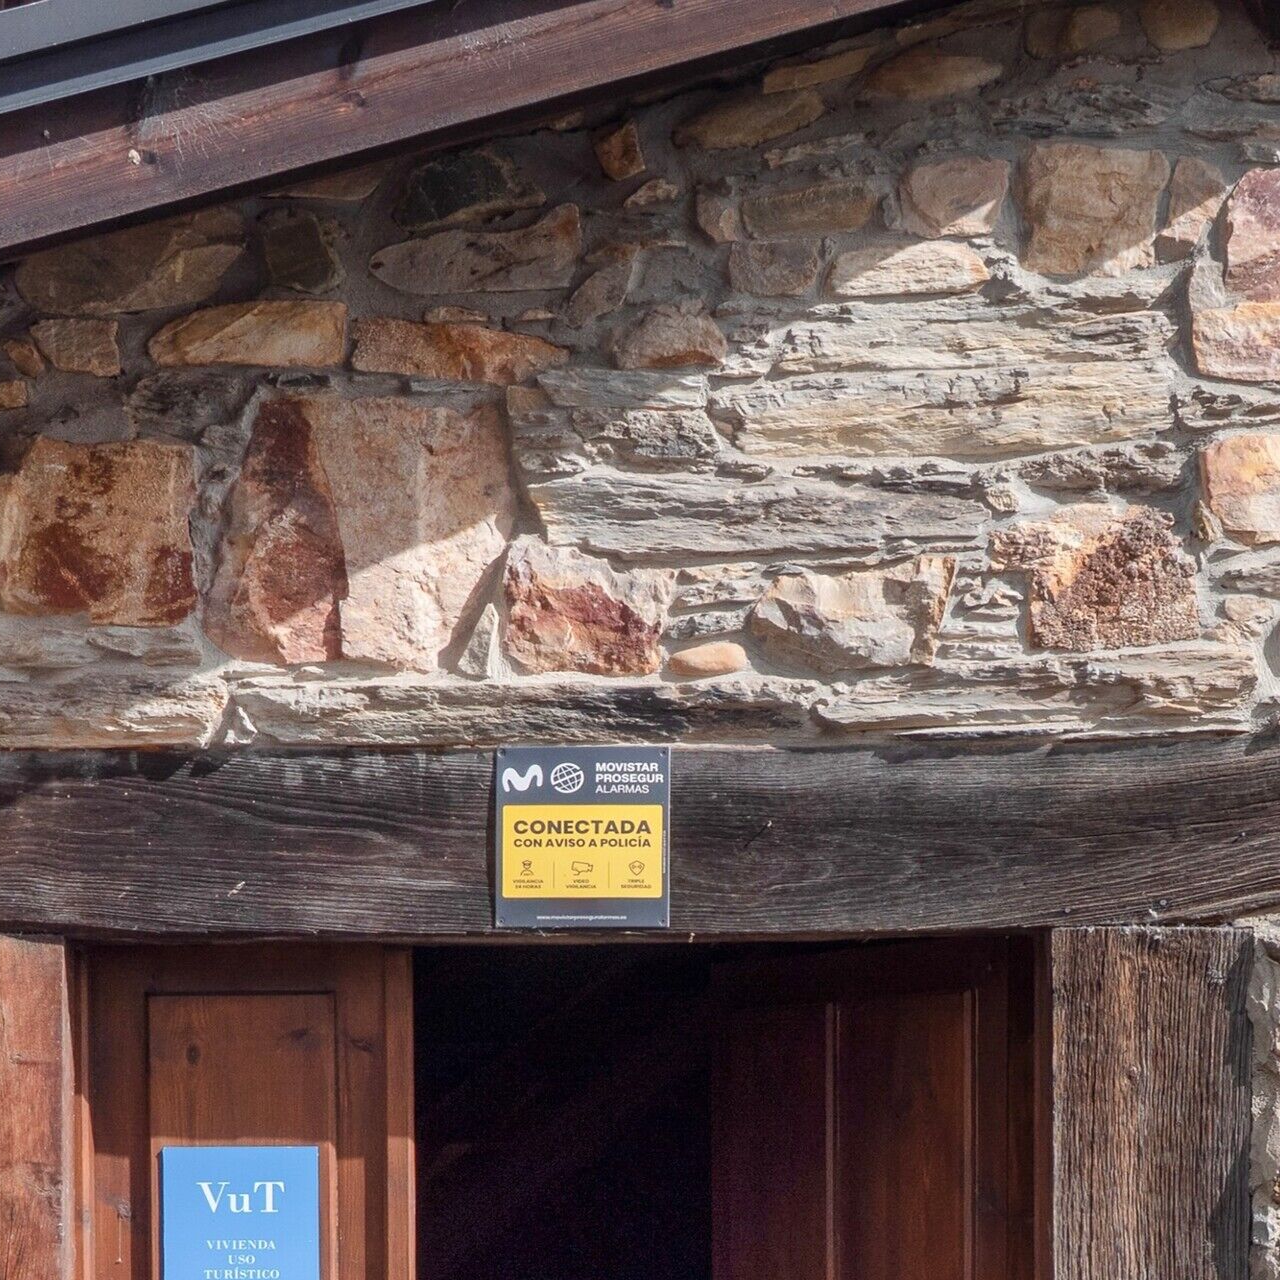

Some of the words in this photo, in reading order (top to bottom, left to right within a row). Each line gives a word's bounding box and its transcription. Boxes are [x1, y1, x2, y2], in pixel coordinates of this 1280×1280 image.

[595, 762, 659, 772] MOVISTAR
[595, 773, 664, 783] PROSEGUR
[595, 784, 650, 794] ALARMAS
[513, 820, 652, 835] CONECTADA
[513, 838, 543, 848] CON
[545, 838, 586, 848] AVISO
[588, 838, 598, 848] A
[600, 836, 652, 848] POLICÍA
[196, 1181, 285, 1213] VuT
[206, 1240, 276, 1250] VIVIENDA
[228, 1254, 256, 1265] USO
[204, 1267, 280, 1280] TURÍSTICO
